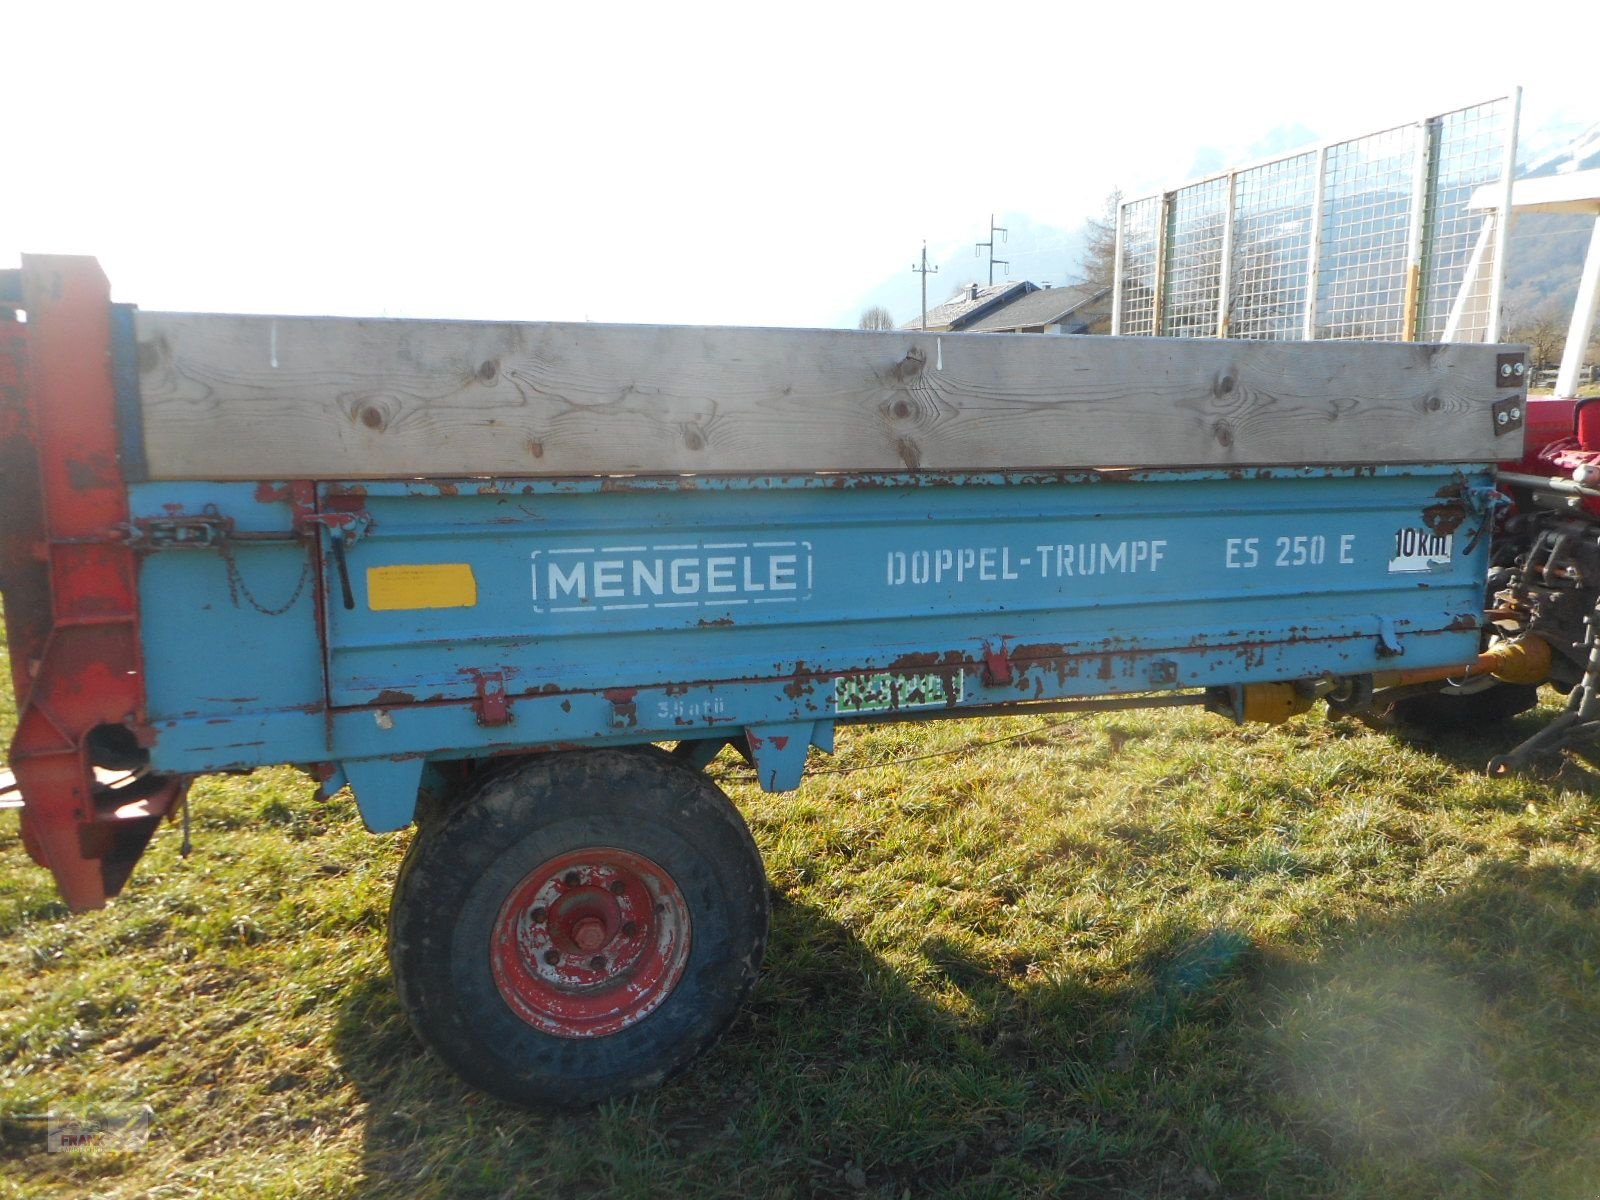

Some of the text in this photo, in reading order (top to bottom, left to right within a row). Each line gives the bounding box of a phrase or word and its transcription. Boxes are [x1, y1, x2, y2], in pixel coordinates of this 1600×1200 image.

[887, 540, 1168, 586] DOPPEL-TRUMPF
[1225, 534, 1356, 568] ES 250 E
[548, 554, 797, 600] MENGELE
